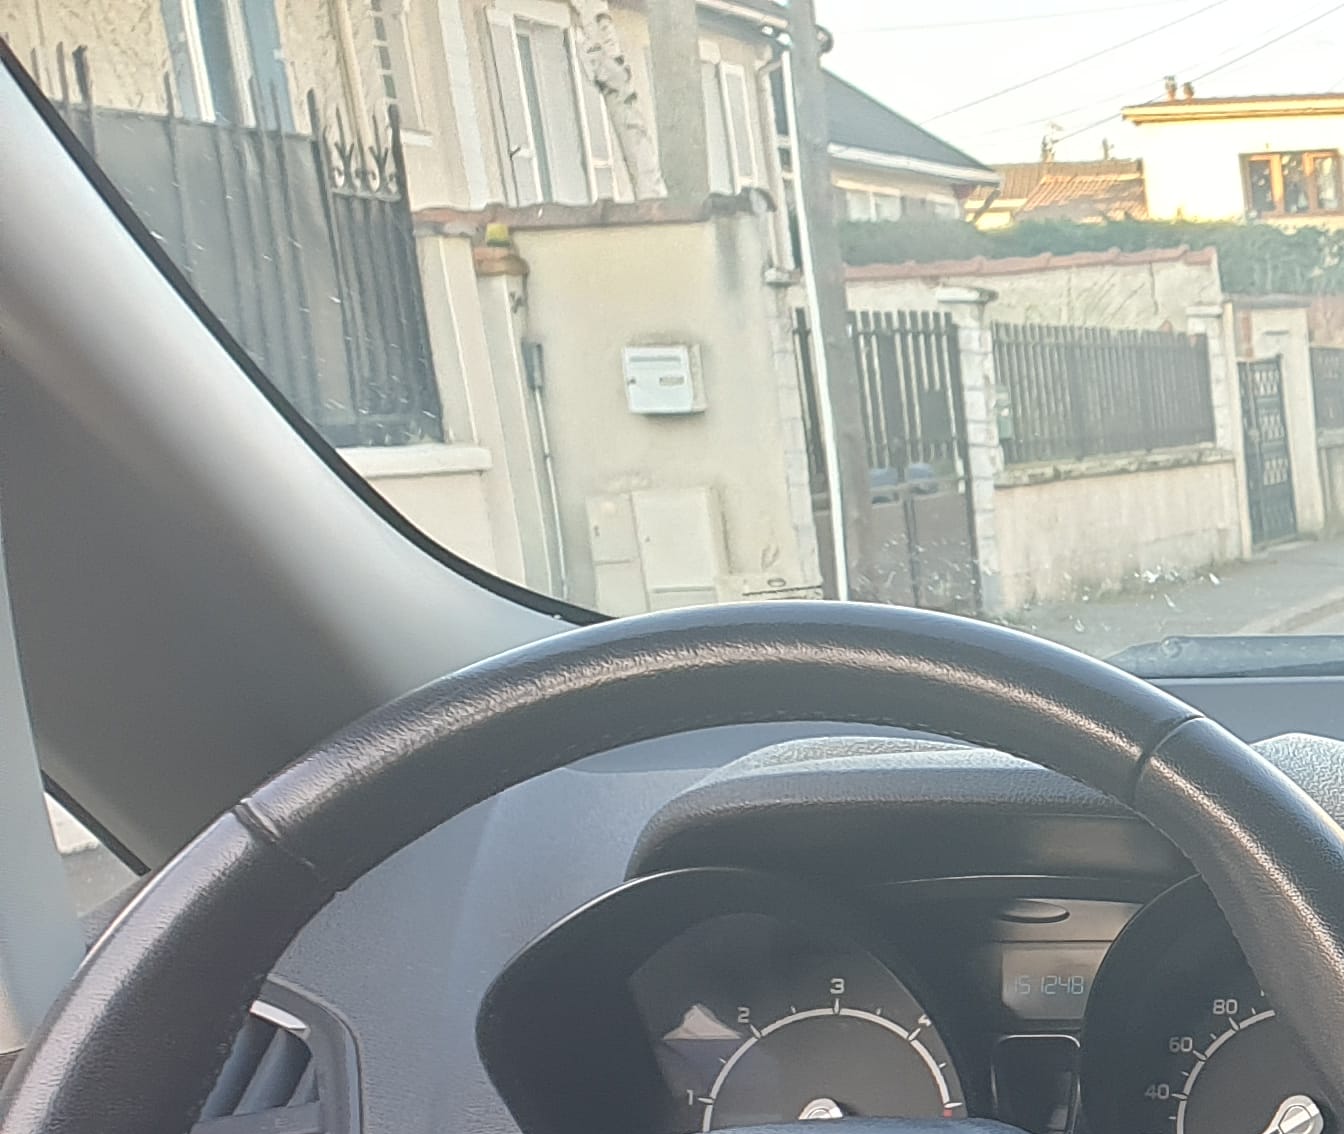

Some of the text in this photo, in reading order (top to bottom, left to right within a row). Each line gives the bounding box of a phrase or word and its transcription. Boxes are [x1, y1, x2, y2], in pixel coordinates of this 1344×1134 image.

[830, 978, 845, 994] 3
[737, 1007, 750, 1023] 2
[1213, 999, 1238, 1015] 80
[1169, 1036, 1193, 1052] 60
[687, 1089, 694, 1105] 1
[1145, 1084, 1169, 1100] 40
